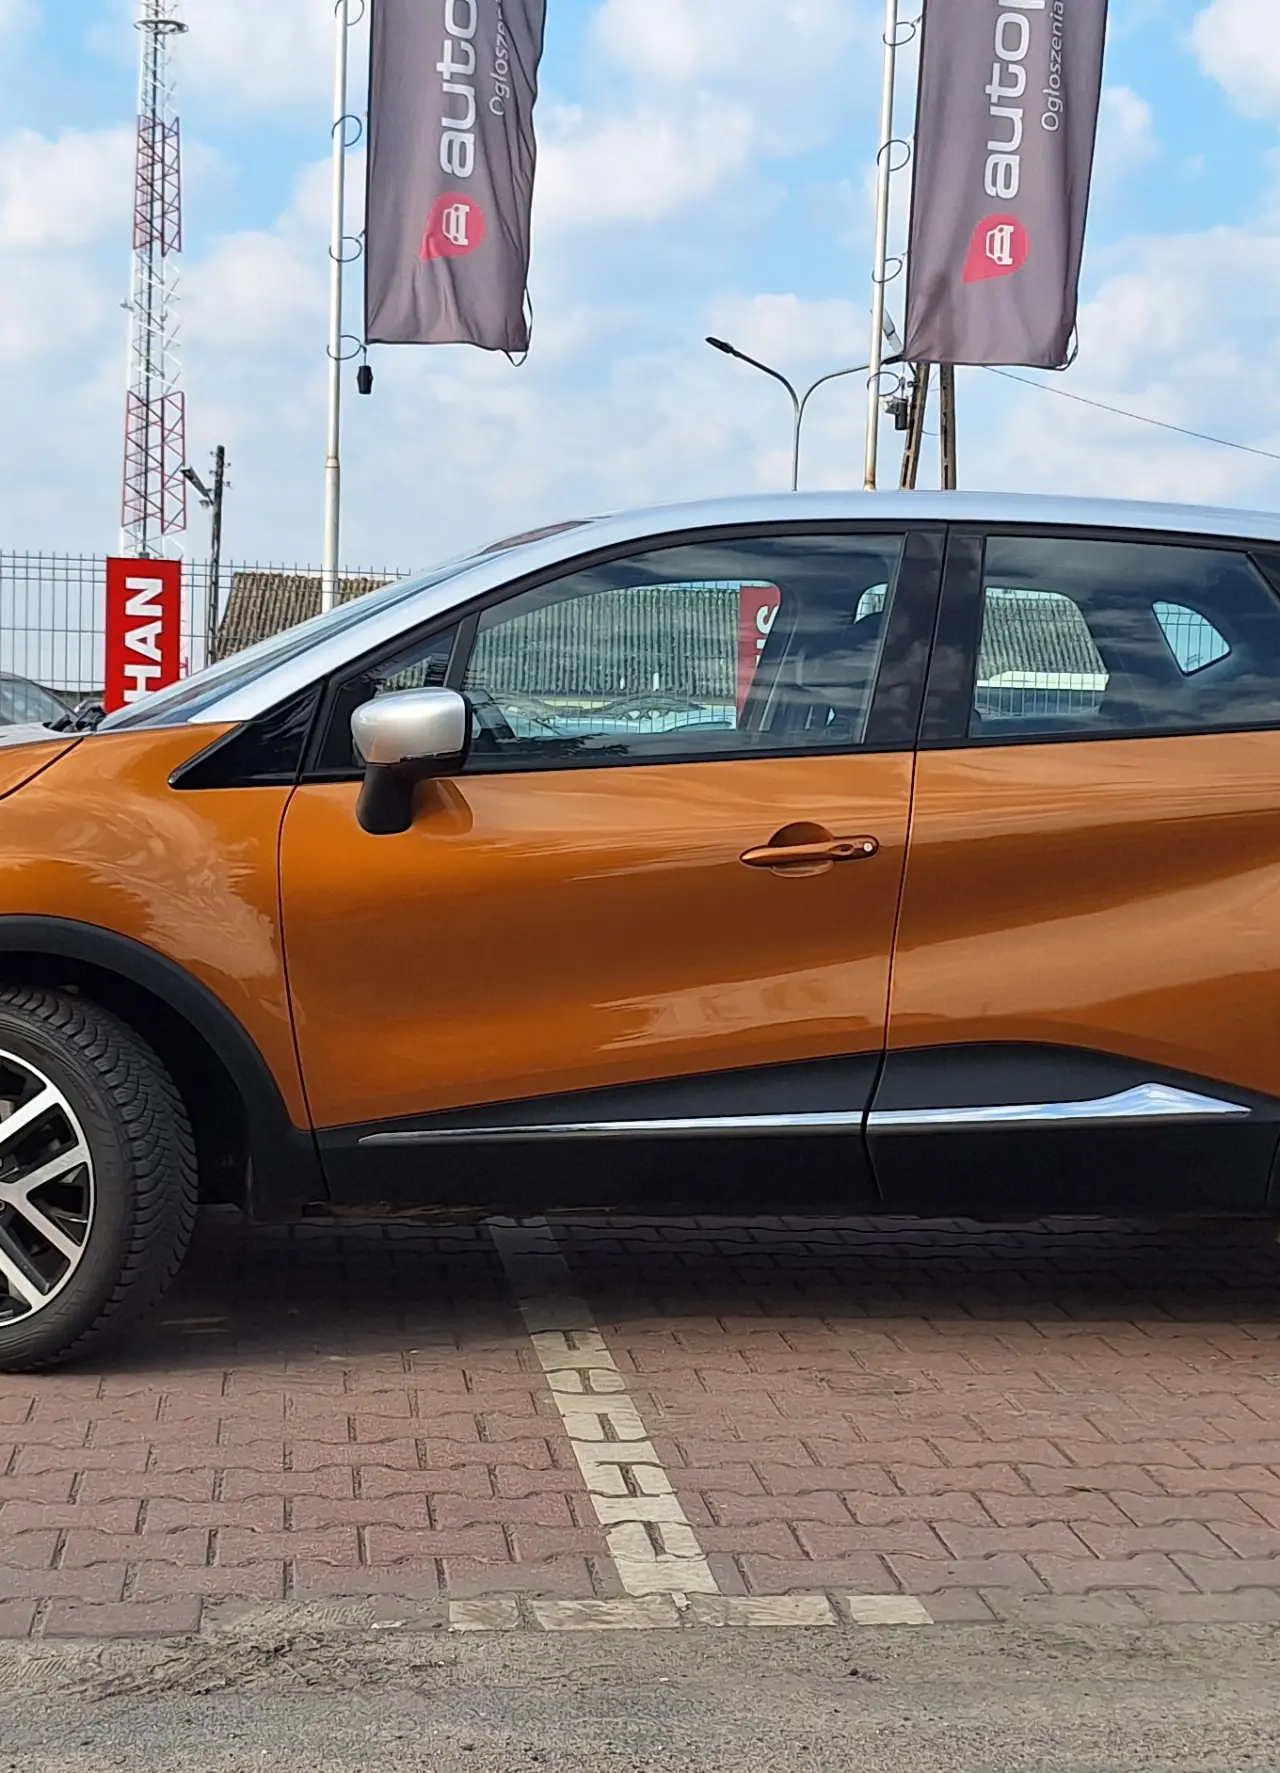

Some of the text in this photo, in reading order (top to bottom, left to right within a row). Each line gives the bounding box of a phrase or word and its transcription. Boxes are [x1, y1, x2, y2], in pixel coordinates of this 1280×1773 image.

[436, 0, 478, 178] auto
[984, 0, 1045, 199] auto
[123, 576, 163, 703] HAN
